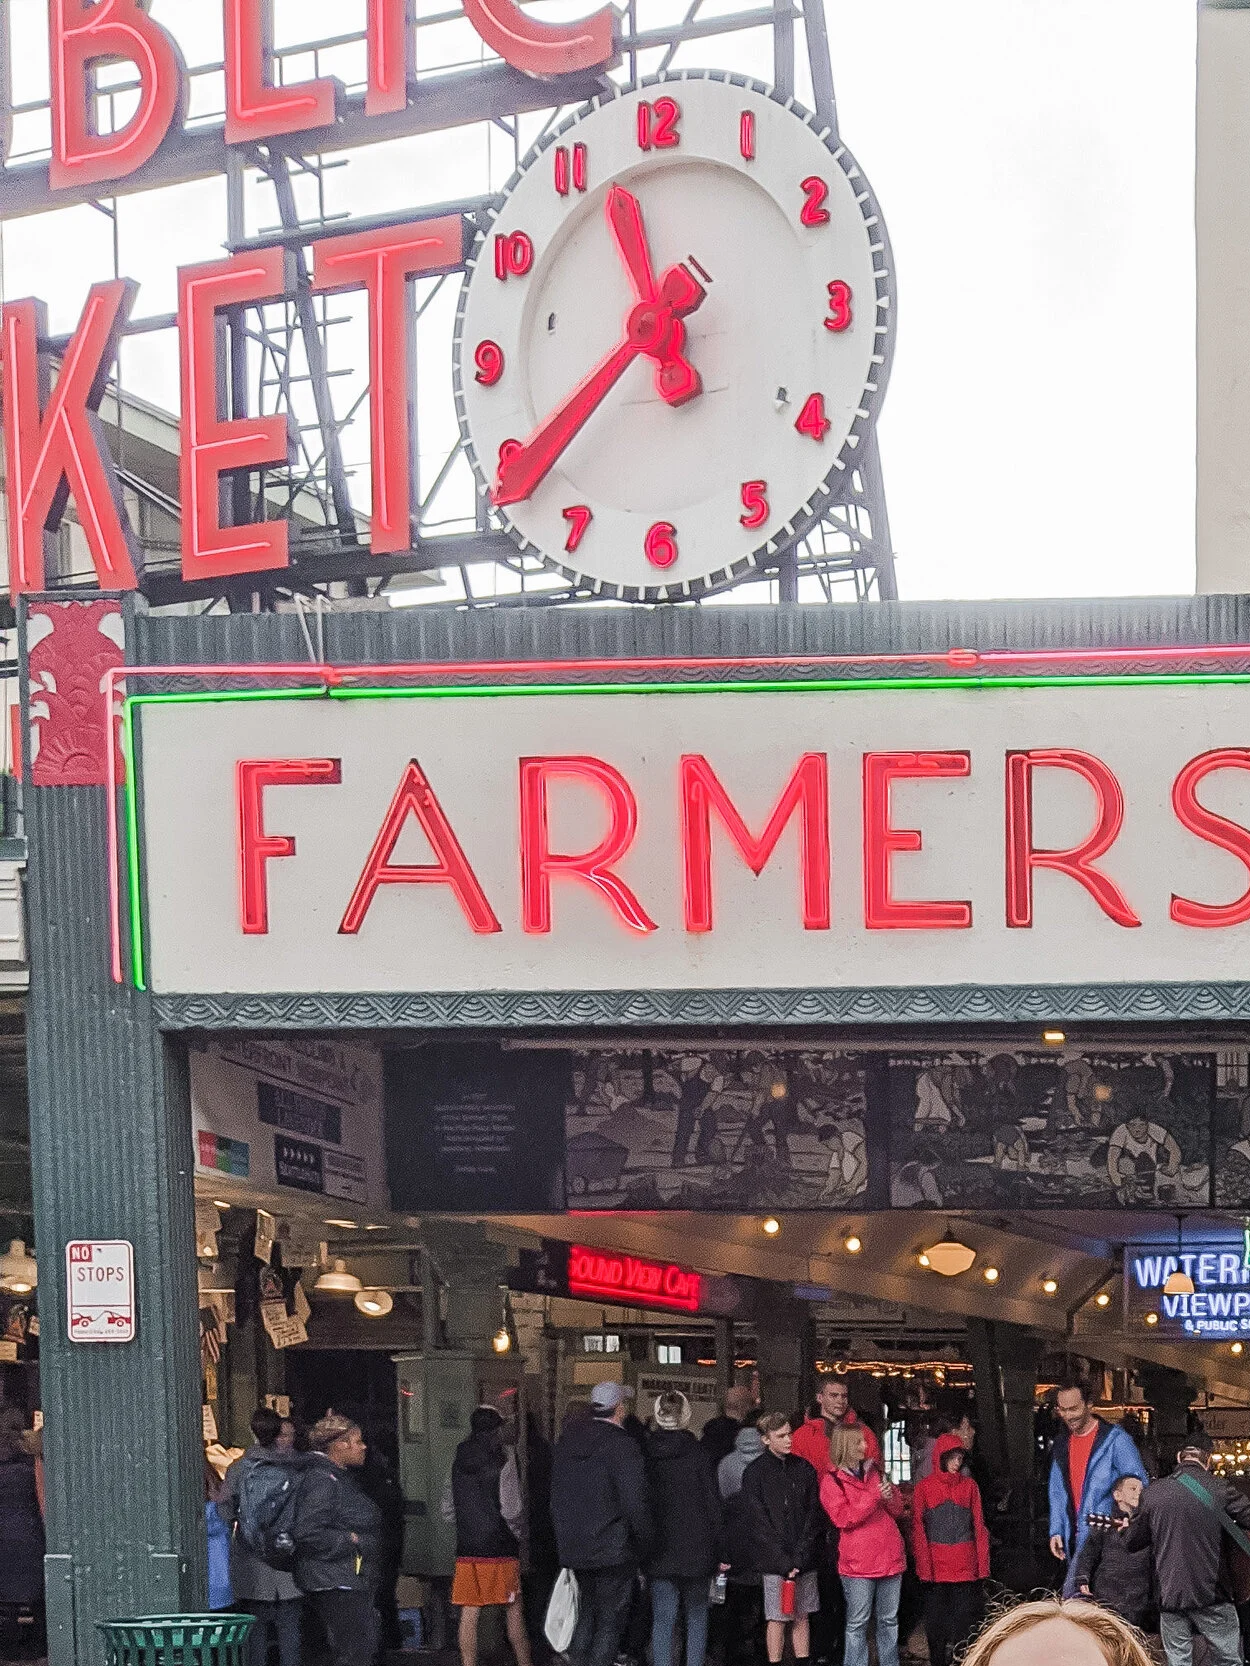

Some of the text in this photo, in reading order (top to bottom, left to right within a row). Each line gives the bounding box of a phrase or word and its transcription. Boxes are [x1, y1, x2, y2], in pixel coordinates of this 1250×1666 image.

[637, 97, 681, 151] 12
[739, 110, 756, 161] 1
[554, 142, 588, 196] 11
[800, 176, 829, 227] 2
[494, 230, 535, 281] 10
[824, 280, 853, 332] 3
[474, 340, 505, 386] 9
[795, 393, 831, 442] 4
[740, 480, 769, 528] 5
[562, 505, 594, 553] 7
[645, 521, 678, 569] 6
[71, 1246, 90, 1260] NO
[77, 1266, 124, 1282] STOPS
[1184, 1319, 1195, 1331] &
[1197, 1319, 1238, 1331] PUBLIC
